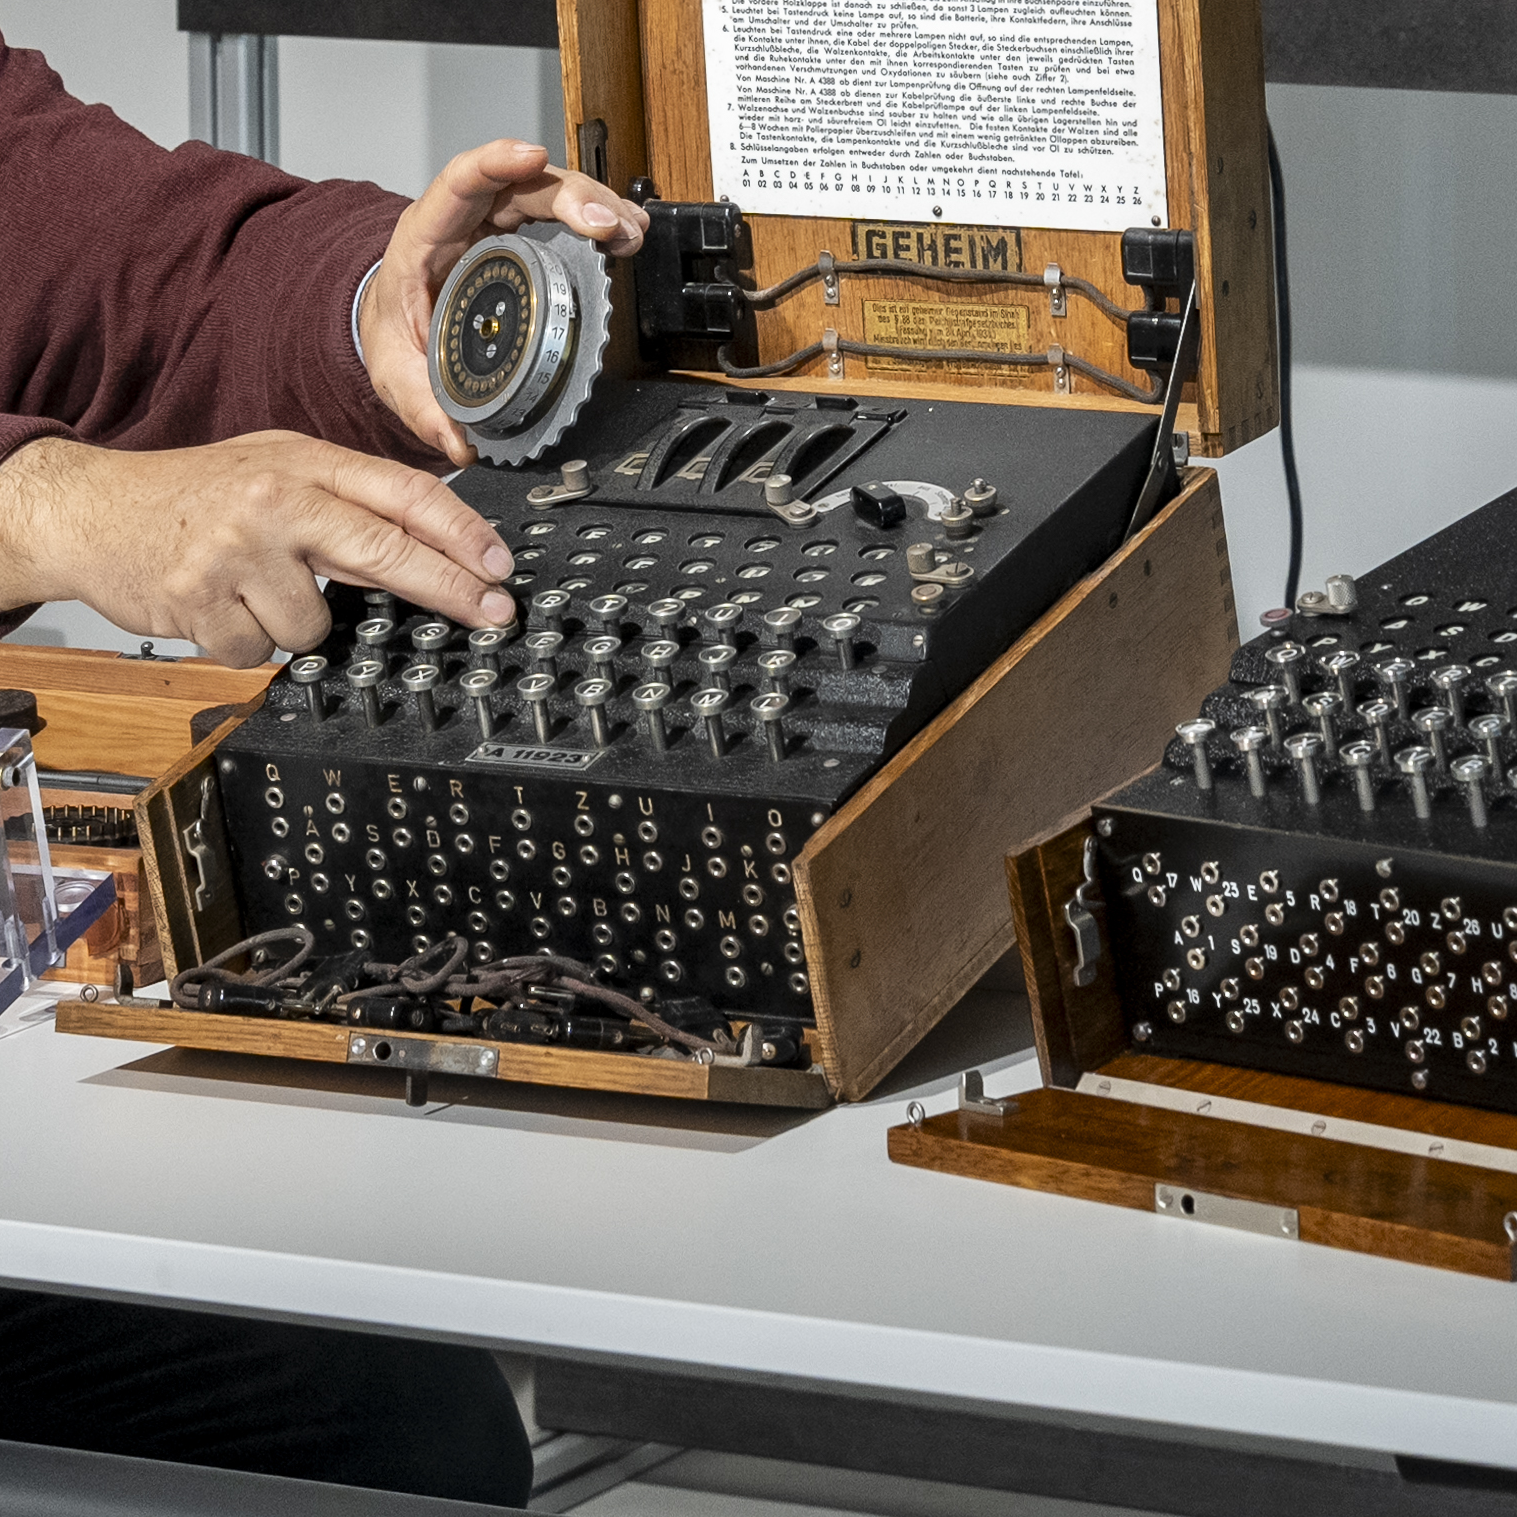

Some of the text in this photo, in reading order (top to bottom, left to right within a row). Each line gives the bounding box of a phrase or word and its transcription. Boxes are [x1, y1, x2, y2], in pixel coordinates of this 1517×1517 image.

[729, 142, 1015, 163] 8. Schlüsselangaben erfolgen entweder durch Zahlen oder Buchstaben.
[865, 229, 1008, 270] GEHEIM
[553, 283, 566, 295] 19
[554, 303, 567, 318] 18
[552, 326, 565, 340] 17
[545, 349, 559, 364] 16
[537, 371, 551, 384] 15
[485, 747, 584, 763] A 11923
[266, 763, 782, 827] Q W E R T Z U I O
[1155, 983, 1375, 1033] P 16 Y 25 X 24 C 3
